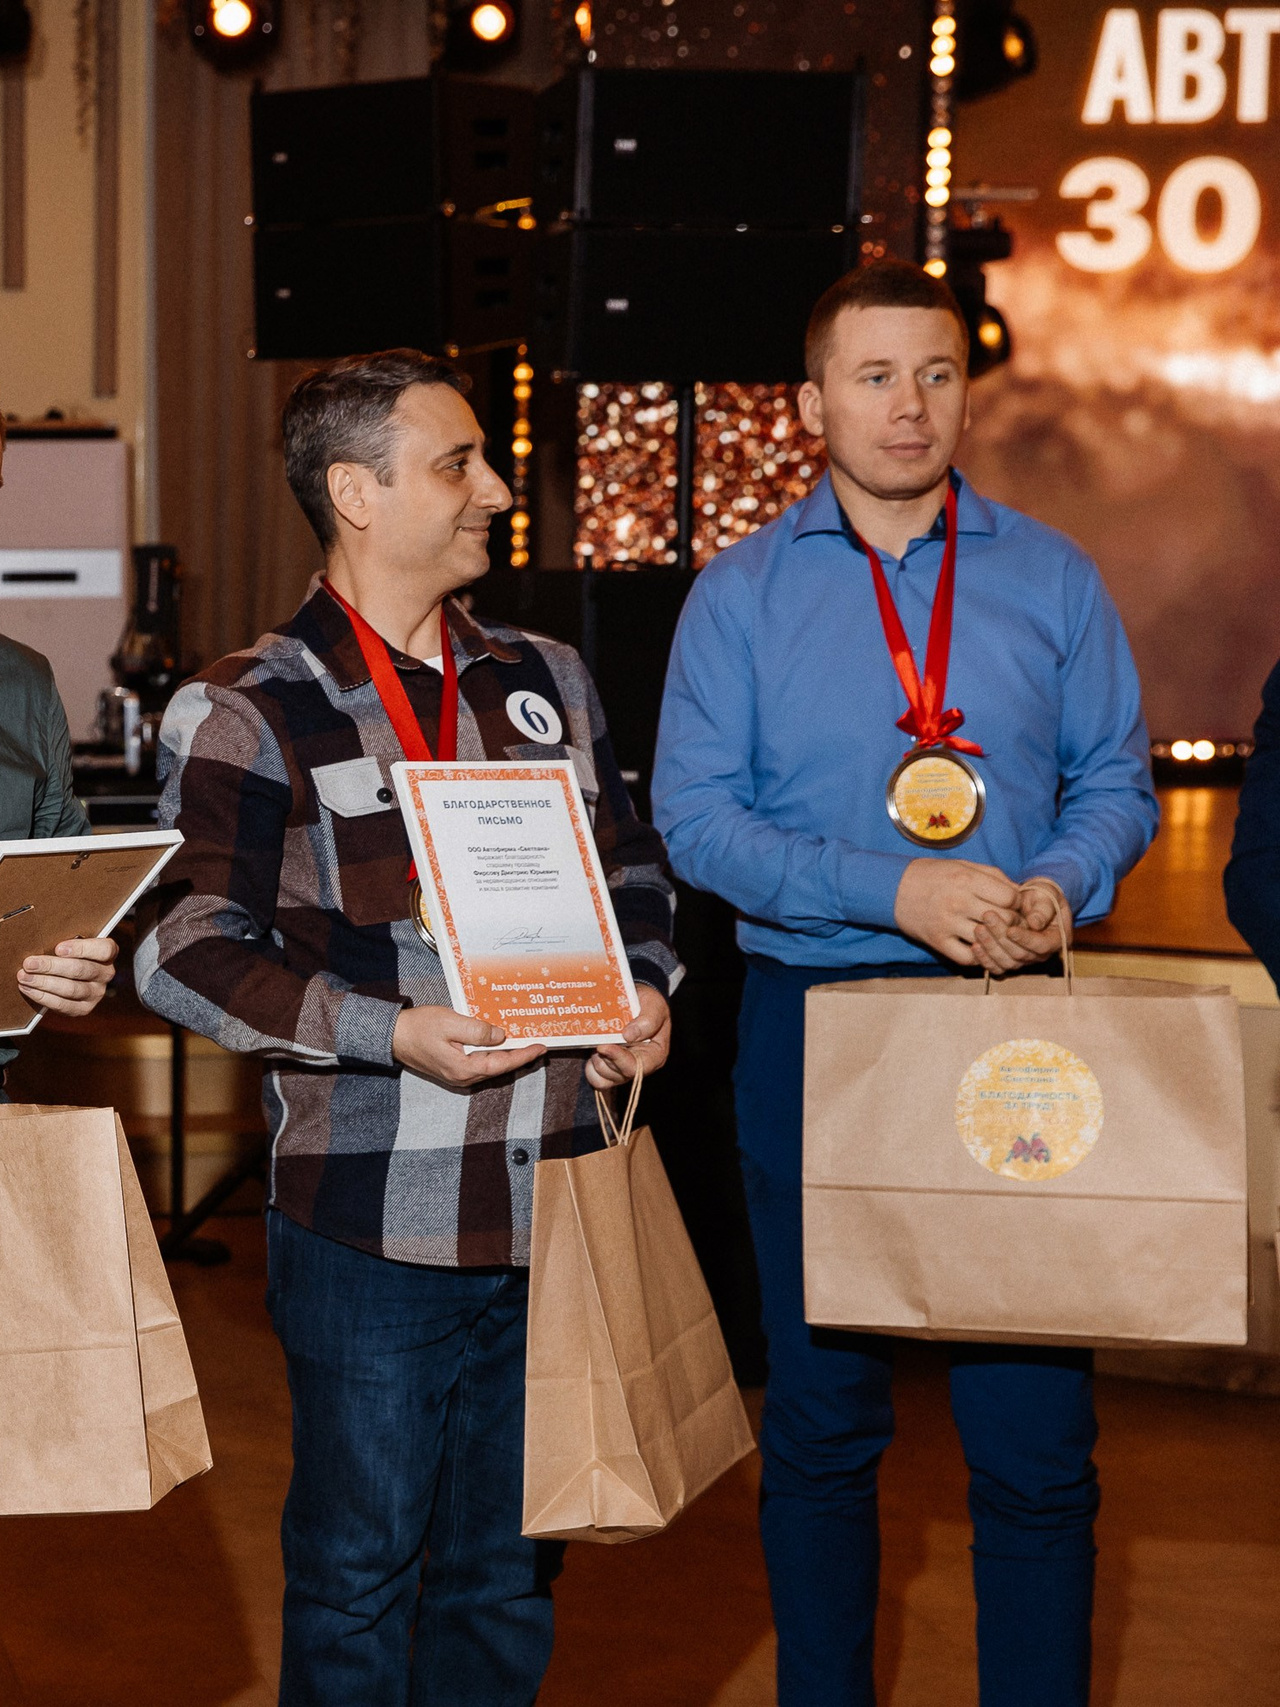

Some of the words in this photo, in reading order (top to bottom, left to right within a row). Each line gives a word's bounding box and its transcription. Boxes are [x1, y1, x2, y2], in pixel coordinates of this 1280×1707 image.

[1080, 7, 1280, 125] АВТ
[1055, 154, 1261, 275] 30
[520, 697, 549, 735] 6
[443, 799, 552, 810] БЛАГОДАРСТВЕННОЕ
[478, 816, 523, 825] ПИСЬМО
[491, 982, 545, 992] Автофирма
[545, 980, 597, 989] «Светлана»
[529, 993, 544, 1004] 30
[546, 994, 565, 1003] лет
[499, 1005, 556, 1019] успешной
[557, 1003, 602, 1016] работы!
